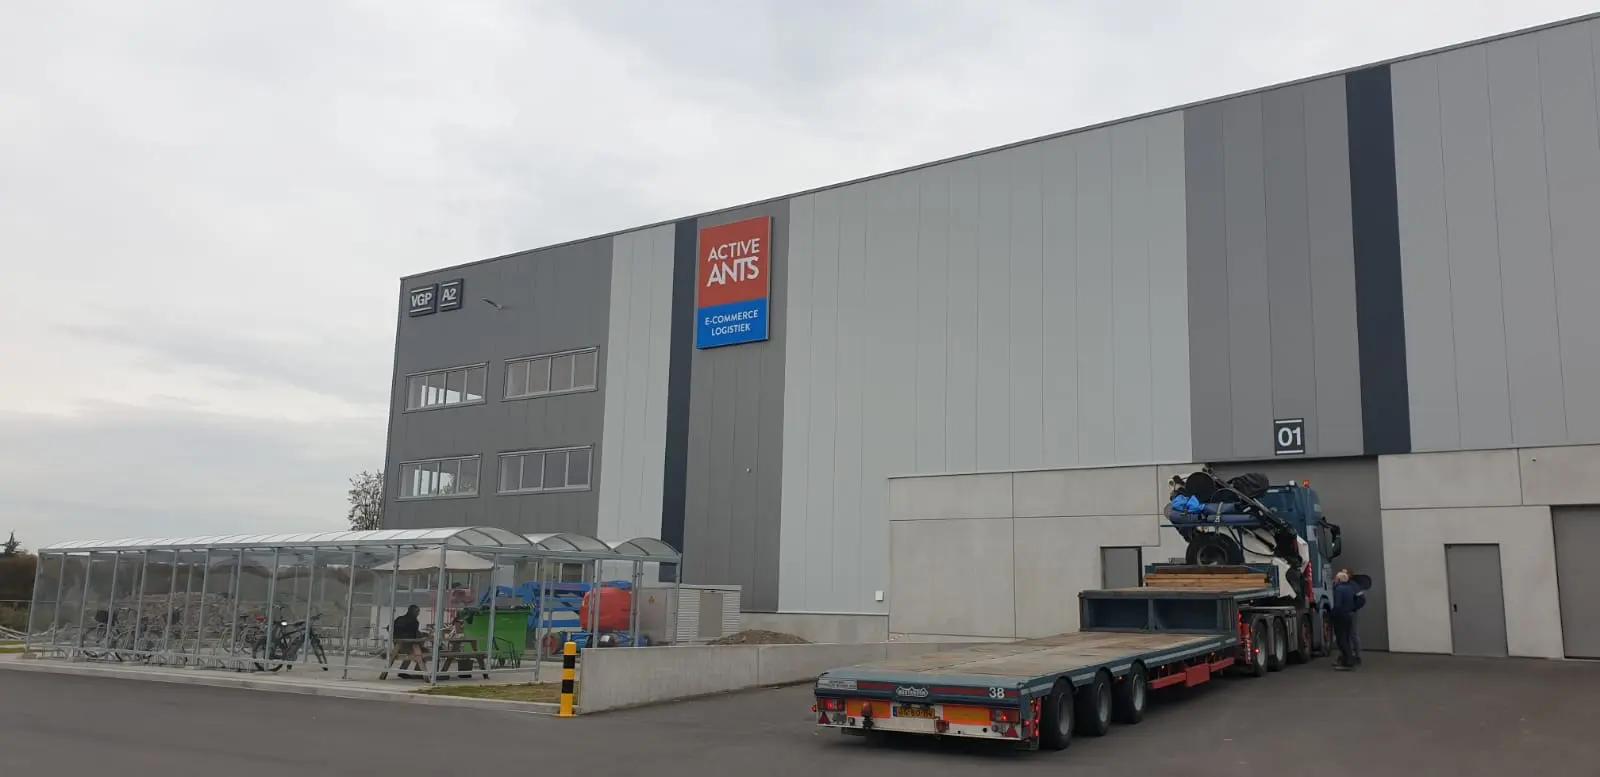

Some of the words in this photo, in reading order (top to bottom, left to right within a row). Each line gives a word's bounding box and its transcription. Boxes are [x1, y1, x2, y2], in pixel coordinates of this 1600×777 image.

[707, 238, 760, 262] ACTIVE
[706, 256, 760, 287] ANTS
[411, 292, 433, 307] VGP
[442, 288, 457, 302] A2
[704, 309, 759, 326] E-COMMERCE
[711, 323, 751, 337] LOGISTIEK
[1278, 427, 1302, 447] 01
[989, 687, 1005, 699] 38
